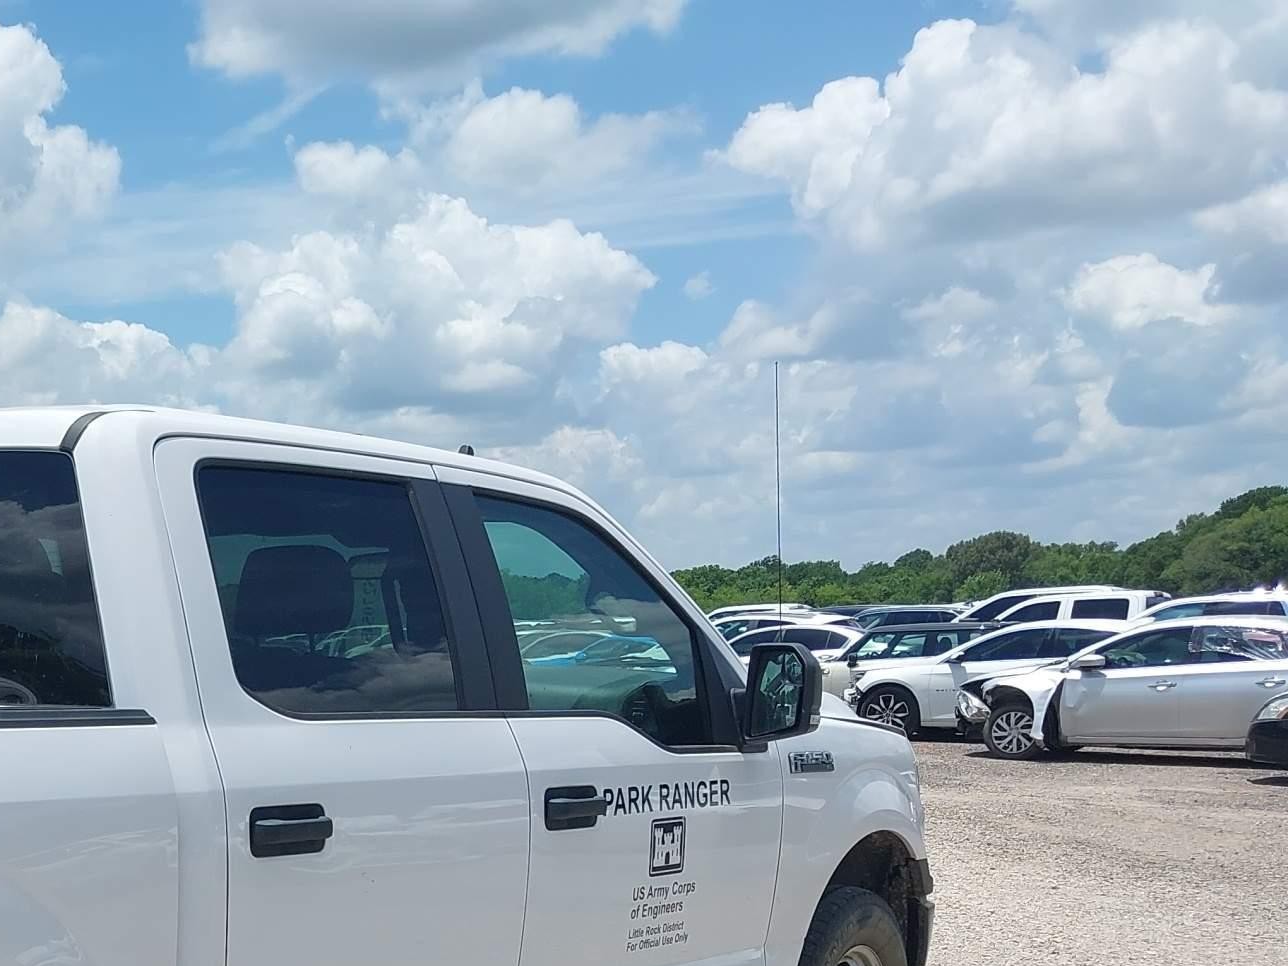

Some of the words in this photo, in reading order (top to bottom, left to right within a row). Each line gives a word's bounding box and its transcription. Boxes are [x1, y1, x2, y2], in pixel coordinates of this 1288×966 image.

[603, 783, 653, 816] PARK
[659, 779, 731, 811] RANGER
[632, 887, 645, 902] US
[647, 884, 669, 899] Army
[672, 881, 696, 896] Corps
[630, 904, 640, 920] of
[641, 900, 683, 920] Engineers
[628, 926, 644, 939] Little
[645, 924, 661, 936] Rock
[662, 920, 684, 933] District
[626, 941, 638, 952] For
[638, 936, 661, 950] Official
[662, 935, 673, 946] Use
[674, 932, 689, 945] Only
